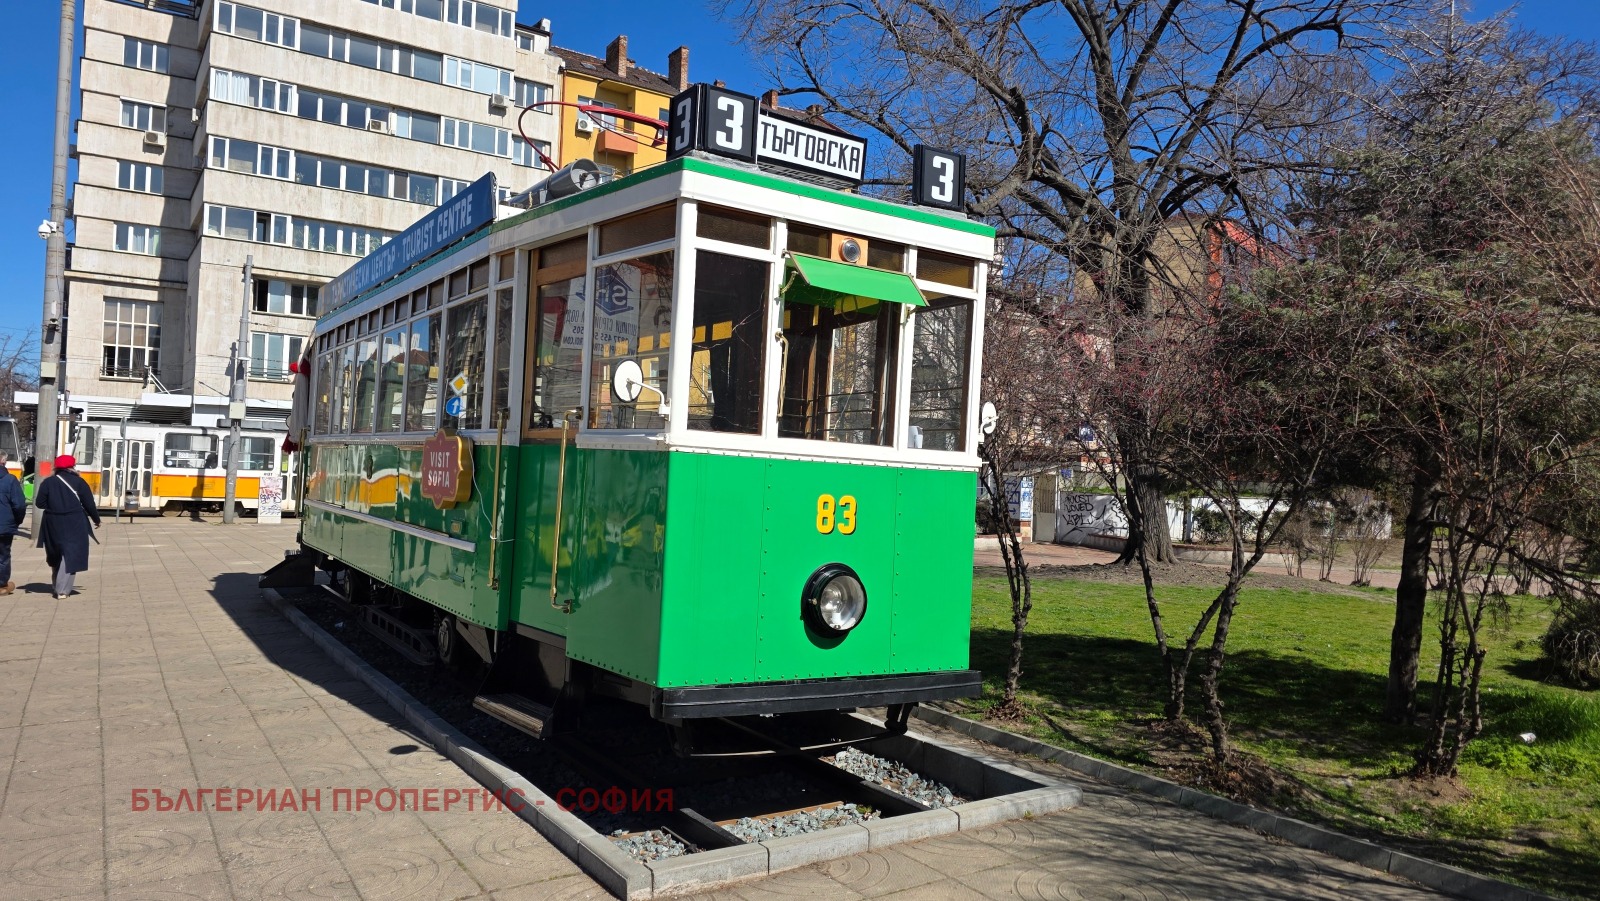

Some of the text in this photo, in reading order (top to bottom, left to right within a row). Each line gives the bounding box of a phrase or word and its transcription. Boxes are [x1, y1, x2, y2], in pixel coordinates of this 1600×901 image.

[674, 97, 692, 151] 3
[715, 96, 744, 151] 3
[760, 121, 861, 173] ТЪРГОВСКА
[931, 155, 954, 203] 3
[371, 245, 396, 283] ЦЕНТЪР
[402, 219, 435, 263] TOURIST
[436, 193, 473, 243] CENTRE
[428, 470, 450, 488] SOFIA
[430, 451, 450, 468] VISIT
[816, 494, 857, 535] 83
